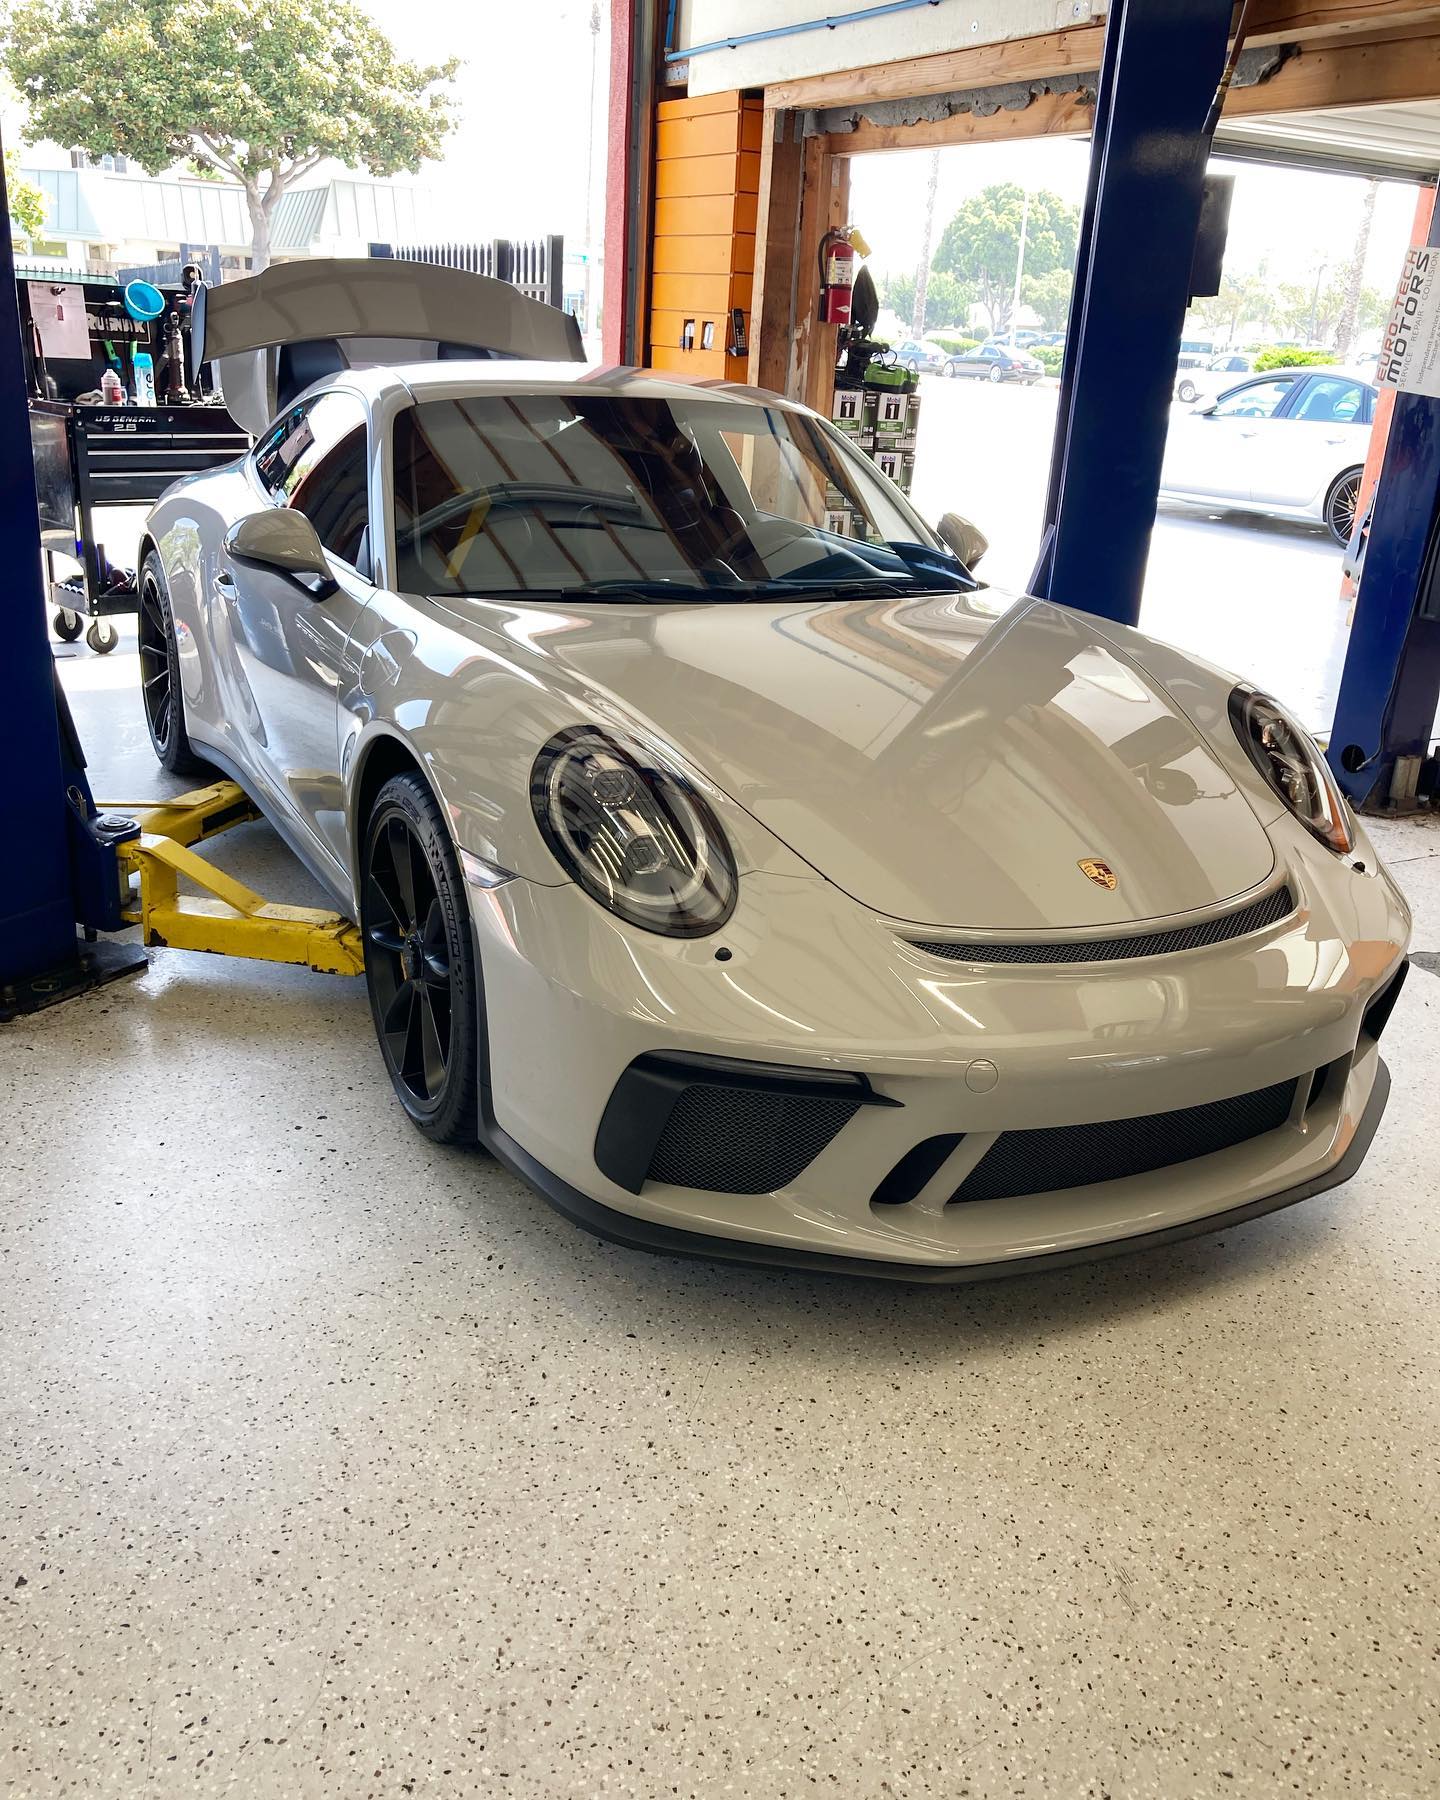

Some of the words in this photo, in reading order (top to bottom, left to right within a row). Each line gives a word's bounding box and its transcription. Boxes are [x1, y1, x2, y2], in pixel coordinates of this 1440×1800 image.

[1376, 250, 1418, 381] EURO-TECH
[1387, 251, 1430, 383] MOTORS
[1399, 352, 1414, 388] SERVICE
[1411, 311, 1424, 342] REPAIR
[1421, 252, 1440, 300] COLLISION
[112, 415, 157, 423] GENERAL
[440, 881, 460, 957] MICHELIN
